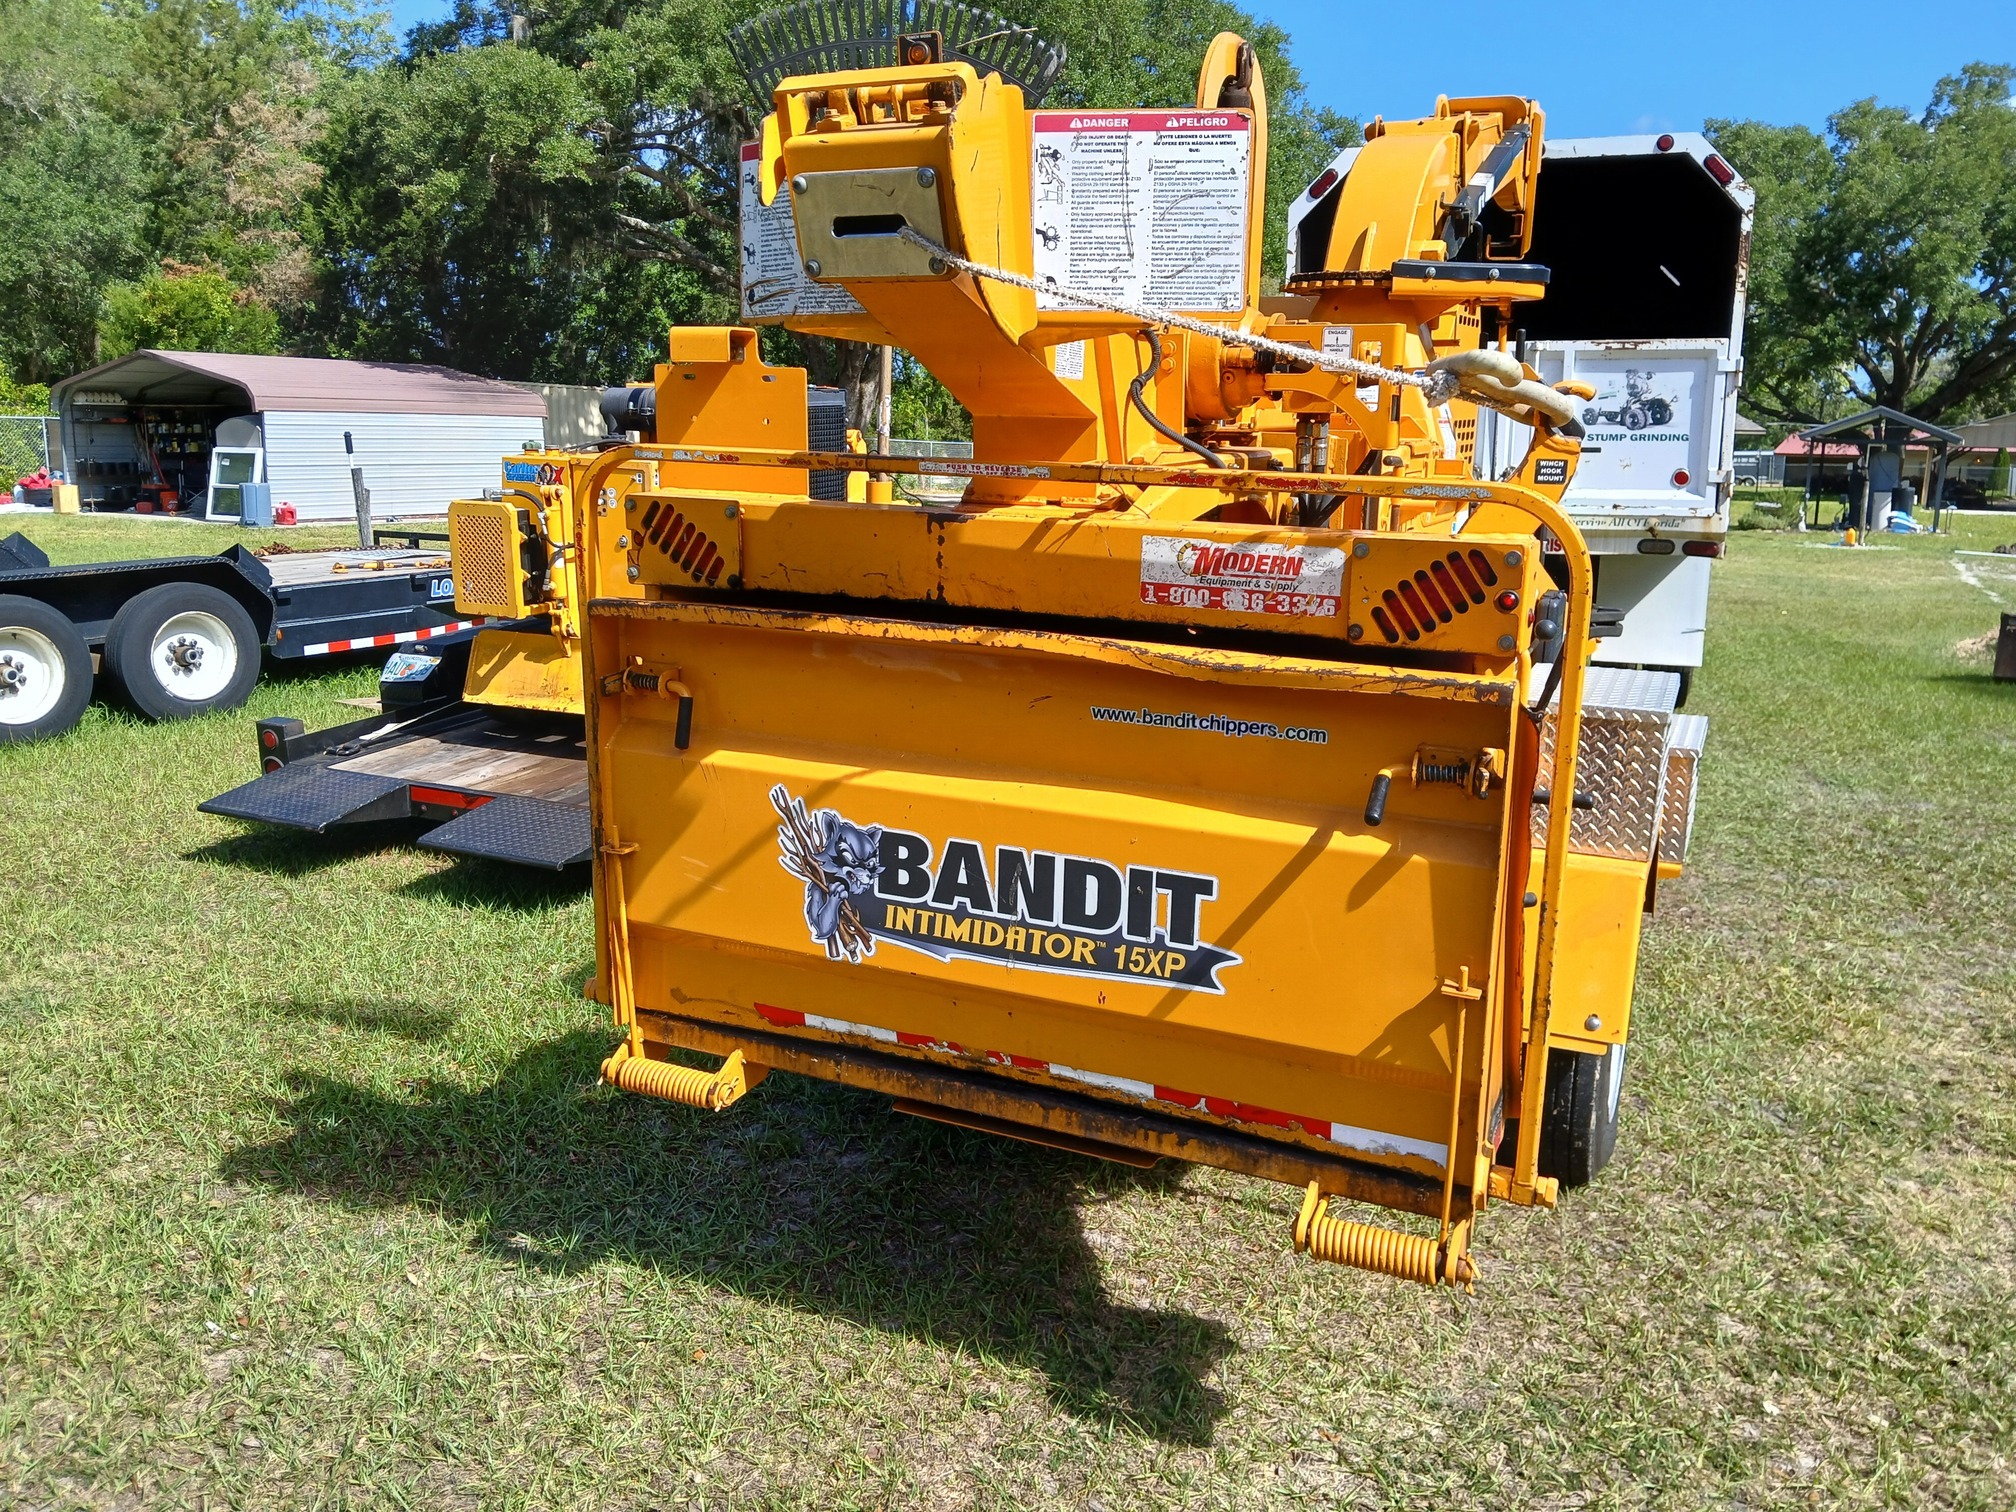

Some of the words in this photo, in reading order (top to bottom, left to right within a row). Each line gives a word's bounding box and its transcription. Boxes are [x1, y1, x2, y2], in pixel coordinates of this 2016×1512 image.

[1083, 118, 1129, 128] DANGER
[1180, 118, 1228, 126] PELIGRO
[1630, 434, 1690, 442] GRINDING
[1191, 544, 1304, 577] MODERN
[431, 578, 454, 597] LO
[1199, 576, 1252, 589] Equipment
[1254, 579, 1261, 588] &
[1264, 580, 1299, 593] Supply
[1091, 706, 1328, 744] www.banditchippers.com
[877, 831, 1214, 946] BANDIT
[1113, 944, 1186, 979] 15XP
